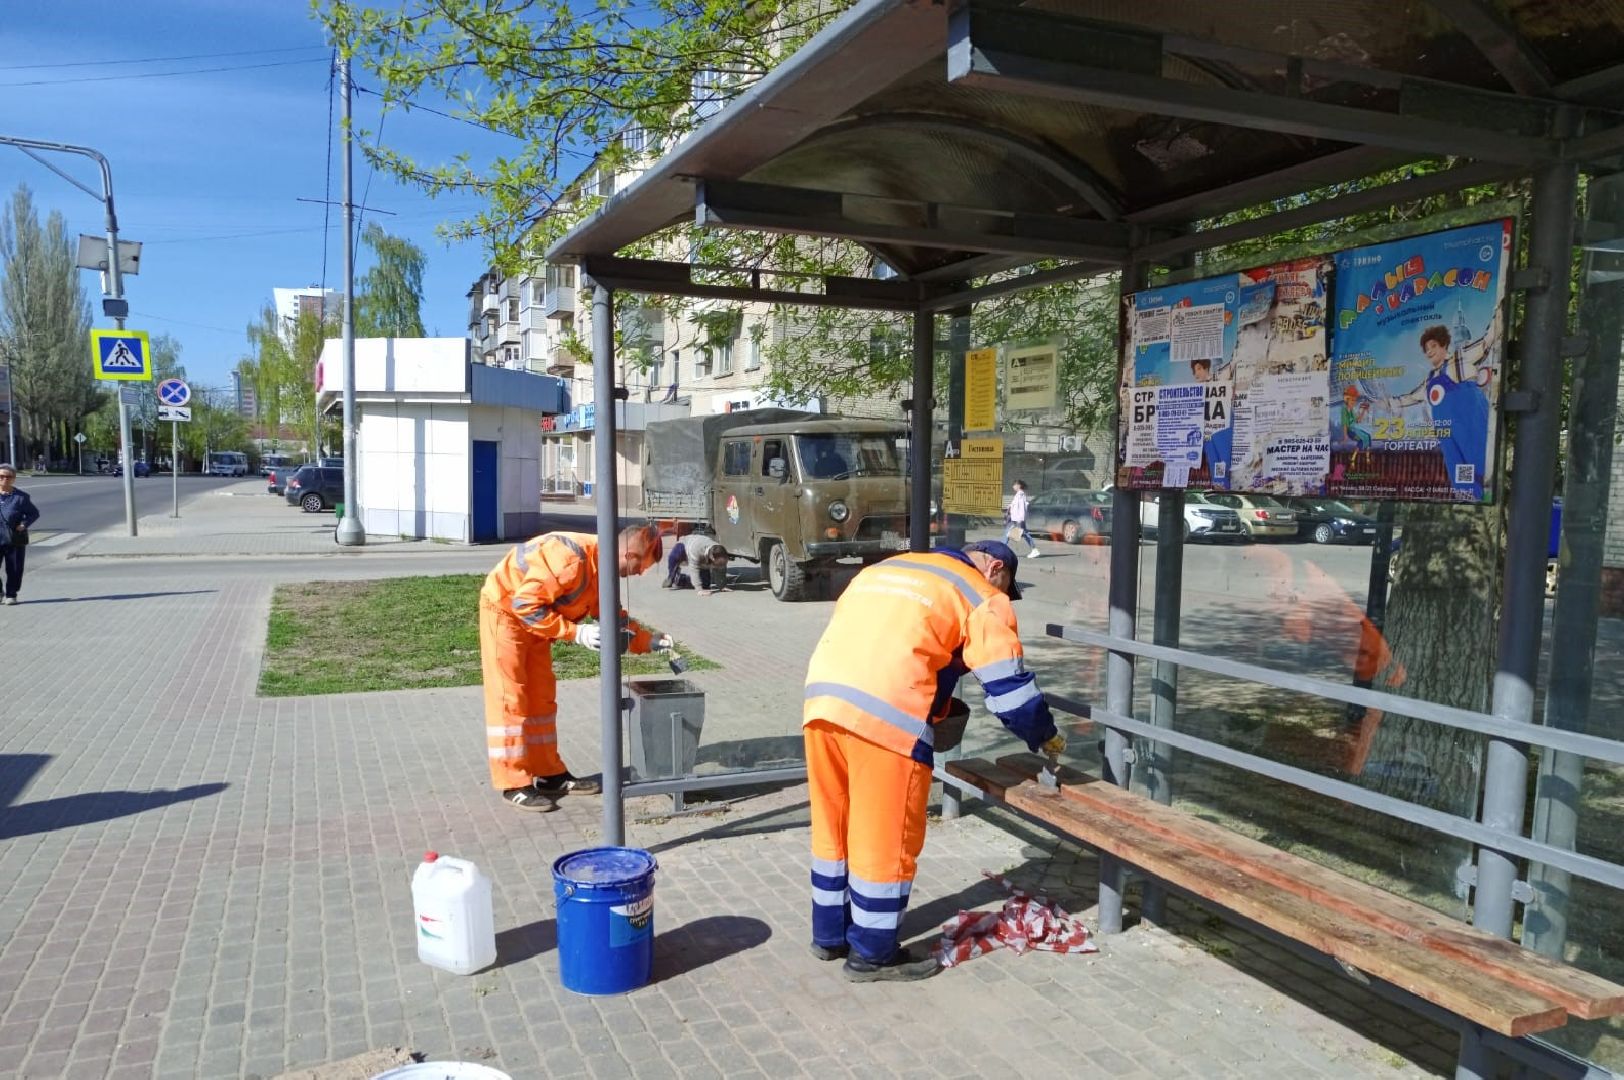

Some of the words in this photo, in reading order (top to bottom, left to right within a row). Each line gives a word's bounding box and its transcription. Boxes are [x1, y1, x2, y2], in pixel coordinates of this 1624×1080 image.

[1375, 417, 1406, 440] 23
[1267, 445, 1300, 454] МАСТЕР
[1302, 444, 1312, 452] НА
